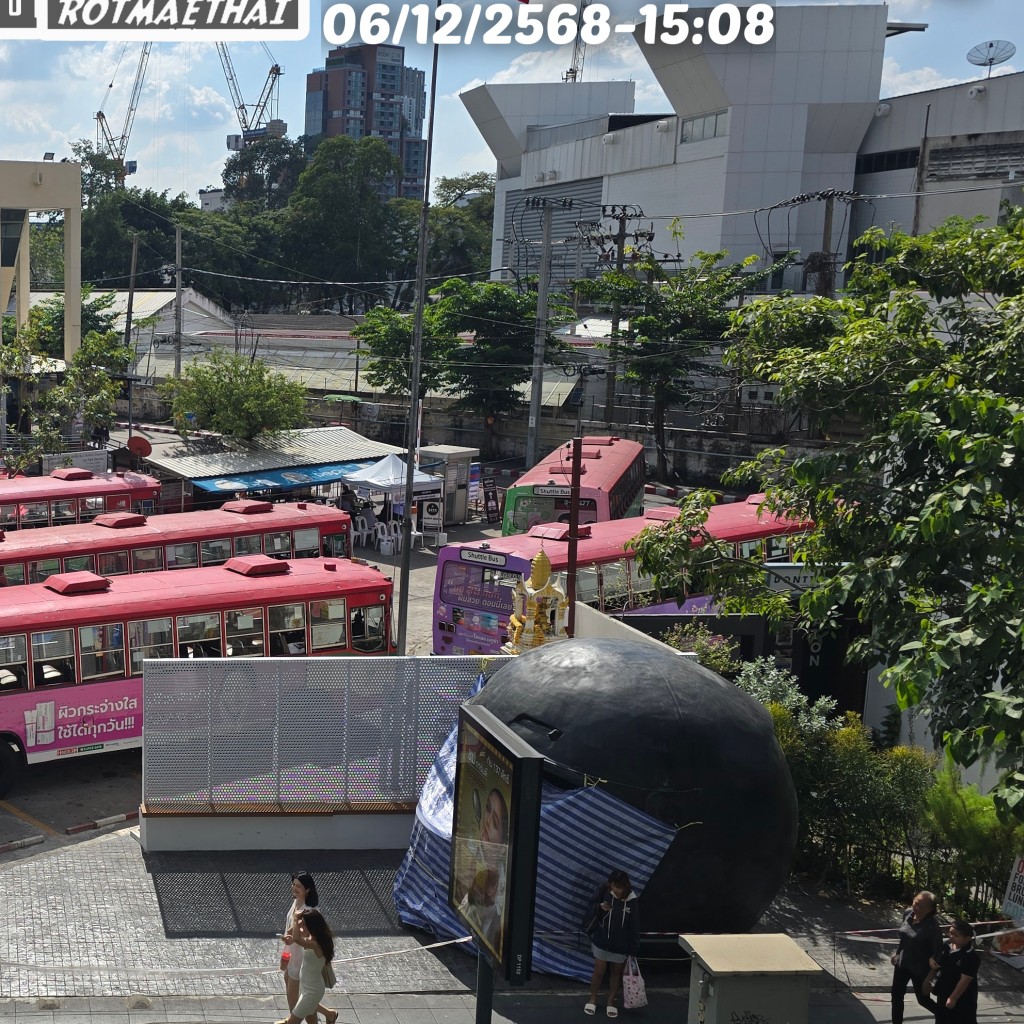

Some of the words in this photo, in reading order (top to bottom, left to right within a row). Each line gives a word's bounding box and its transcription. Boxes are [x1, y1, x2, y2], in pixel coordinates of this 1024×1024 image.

[467, 551, 487, 561] Shuttle
[488, 554, 499, 563] Bus
[57, 696, 139, 720] ผิวกระจ่างใส
[57, 716, 136, 739] ใช้ได้ทุกวัน!!!
